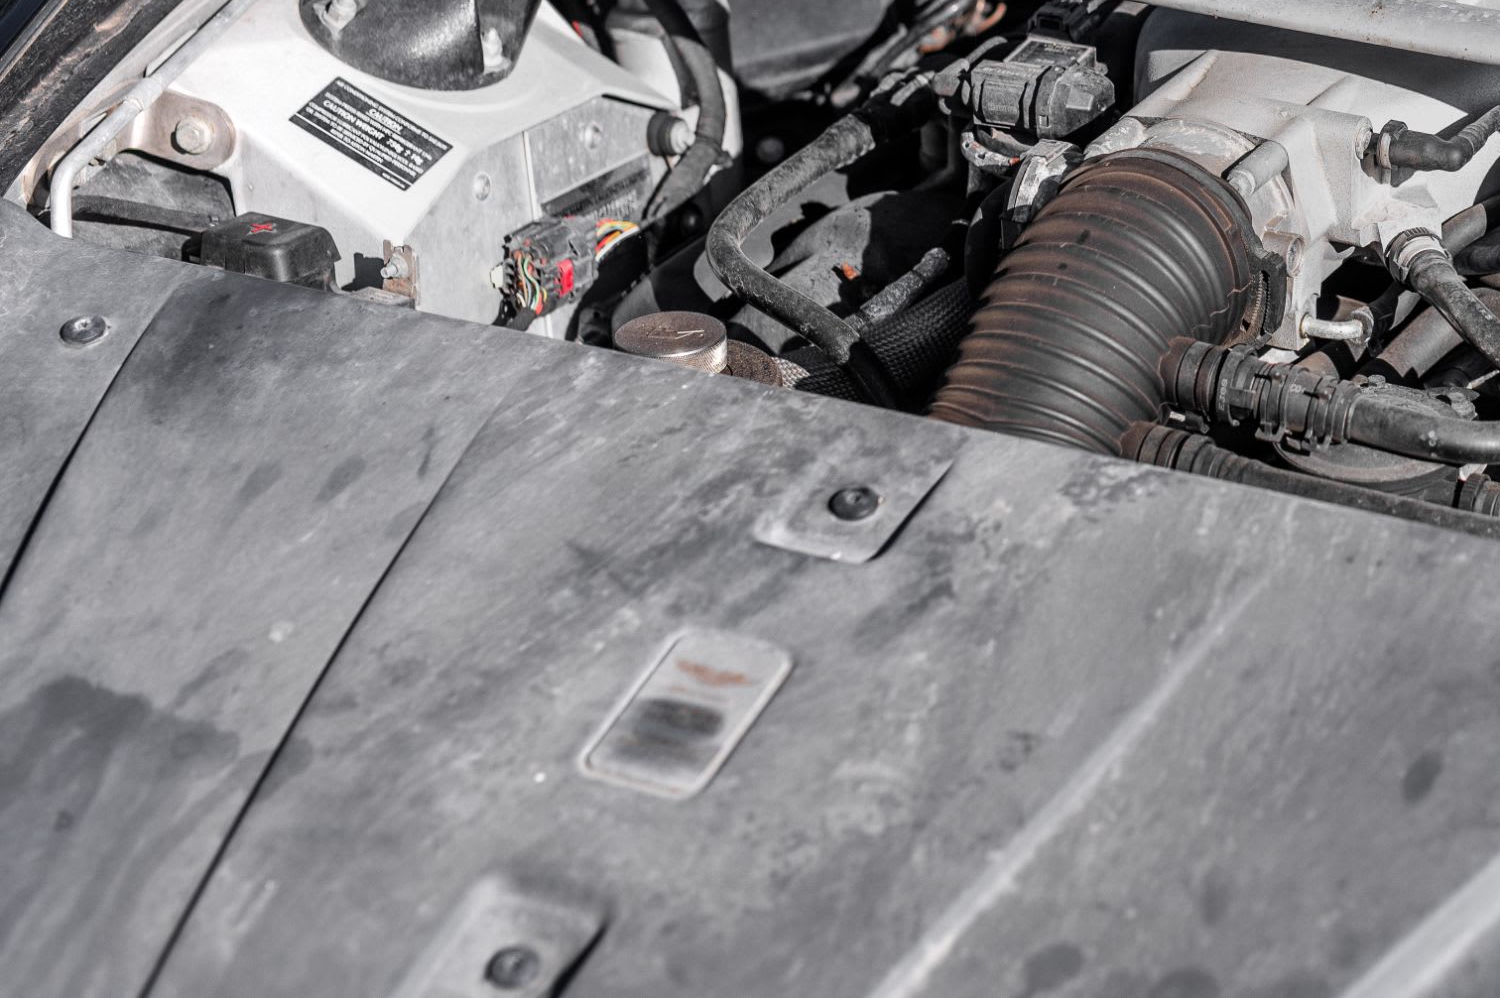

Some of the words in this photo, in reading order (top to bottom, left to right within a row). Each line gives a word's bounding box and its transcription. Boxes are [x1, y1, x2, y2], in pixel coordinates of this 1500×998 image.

[321, 99, 358, 123] CAUTION
[353, 119, 386, 140] WEIGHT
[367, 108, 404, 132] CAUTION
